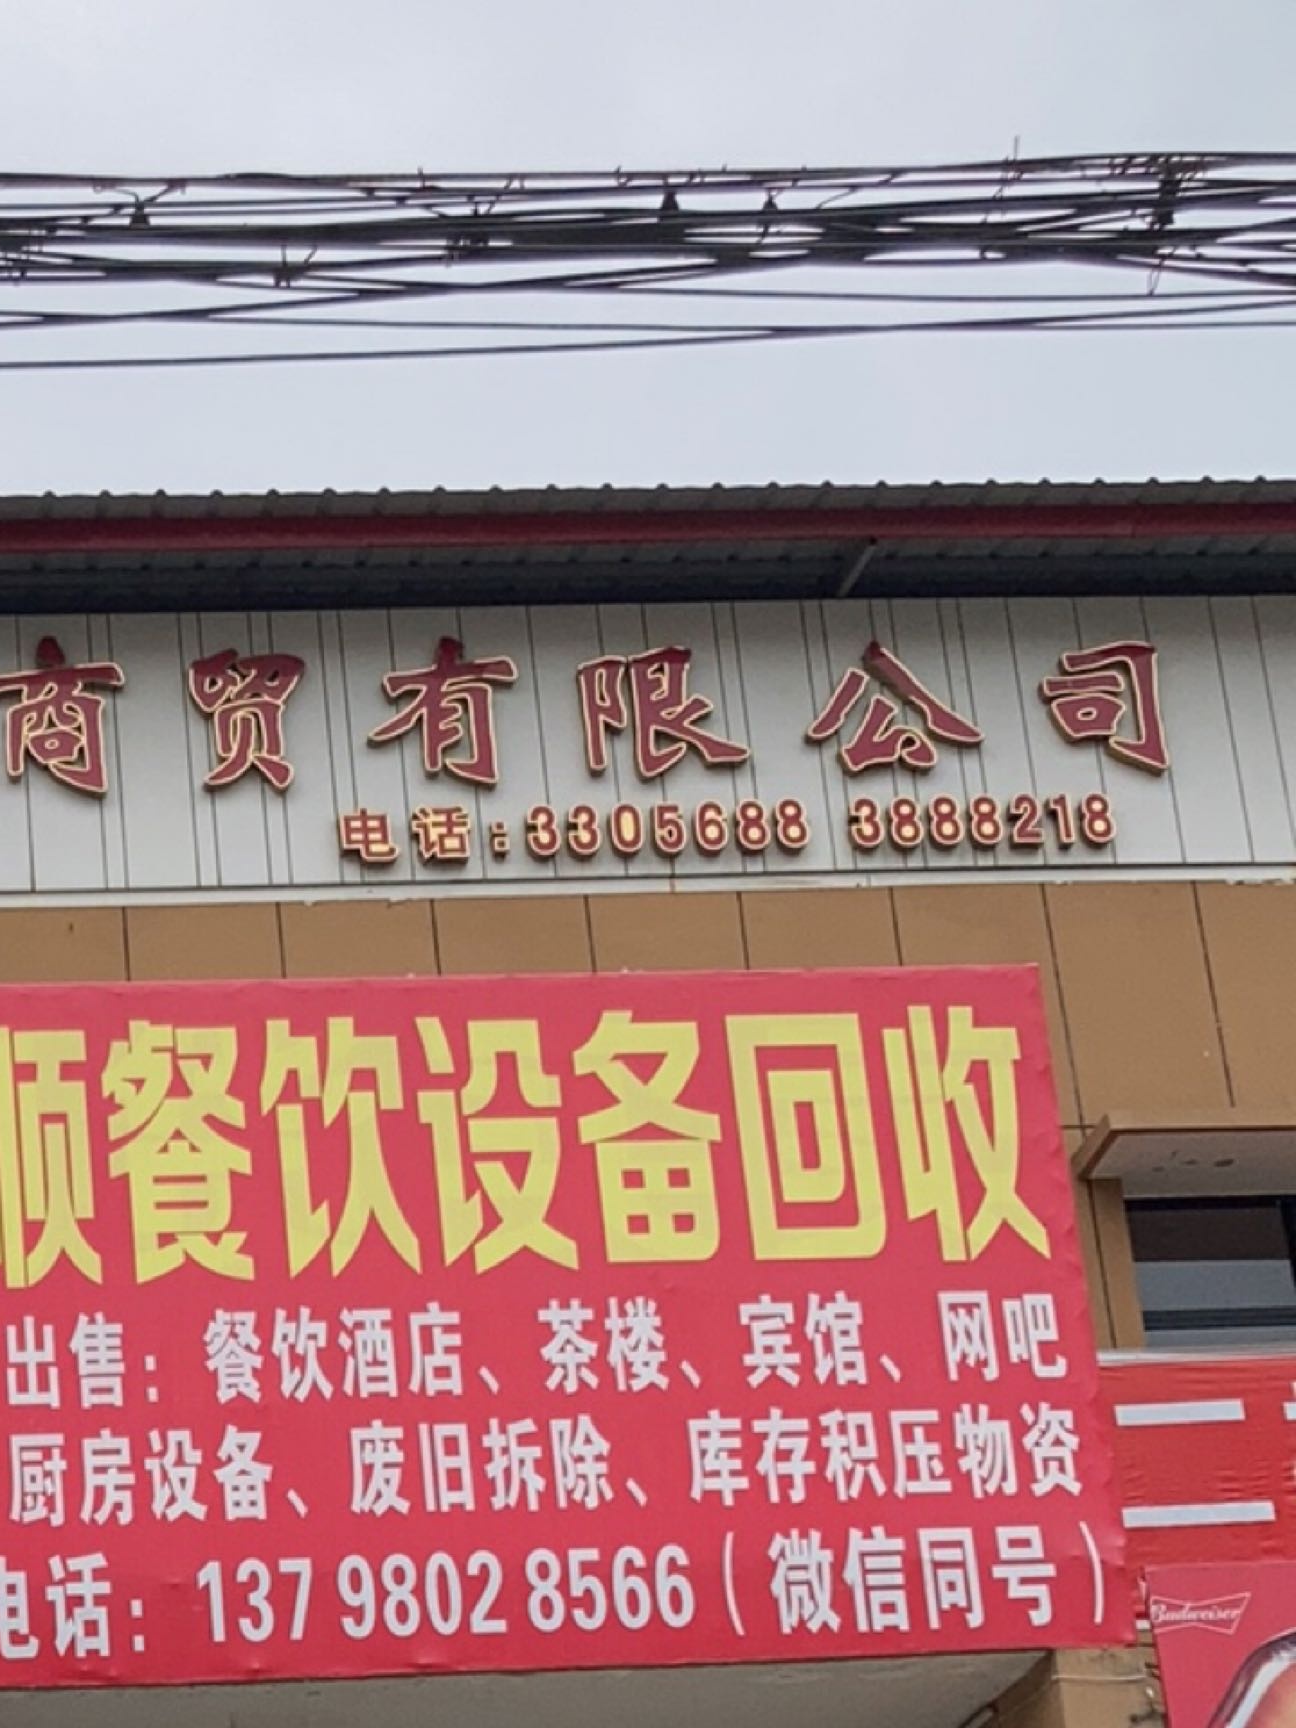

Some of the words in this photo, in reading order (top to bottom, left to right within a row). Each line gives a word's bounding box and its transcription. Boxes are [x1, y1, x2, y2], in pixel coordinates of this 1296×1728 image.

[848, 791, 1119, 848] 3888218
[337, 1550, 507, 1639] 9802
[1151, 1603, 1242, 1625] Budweiser
